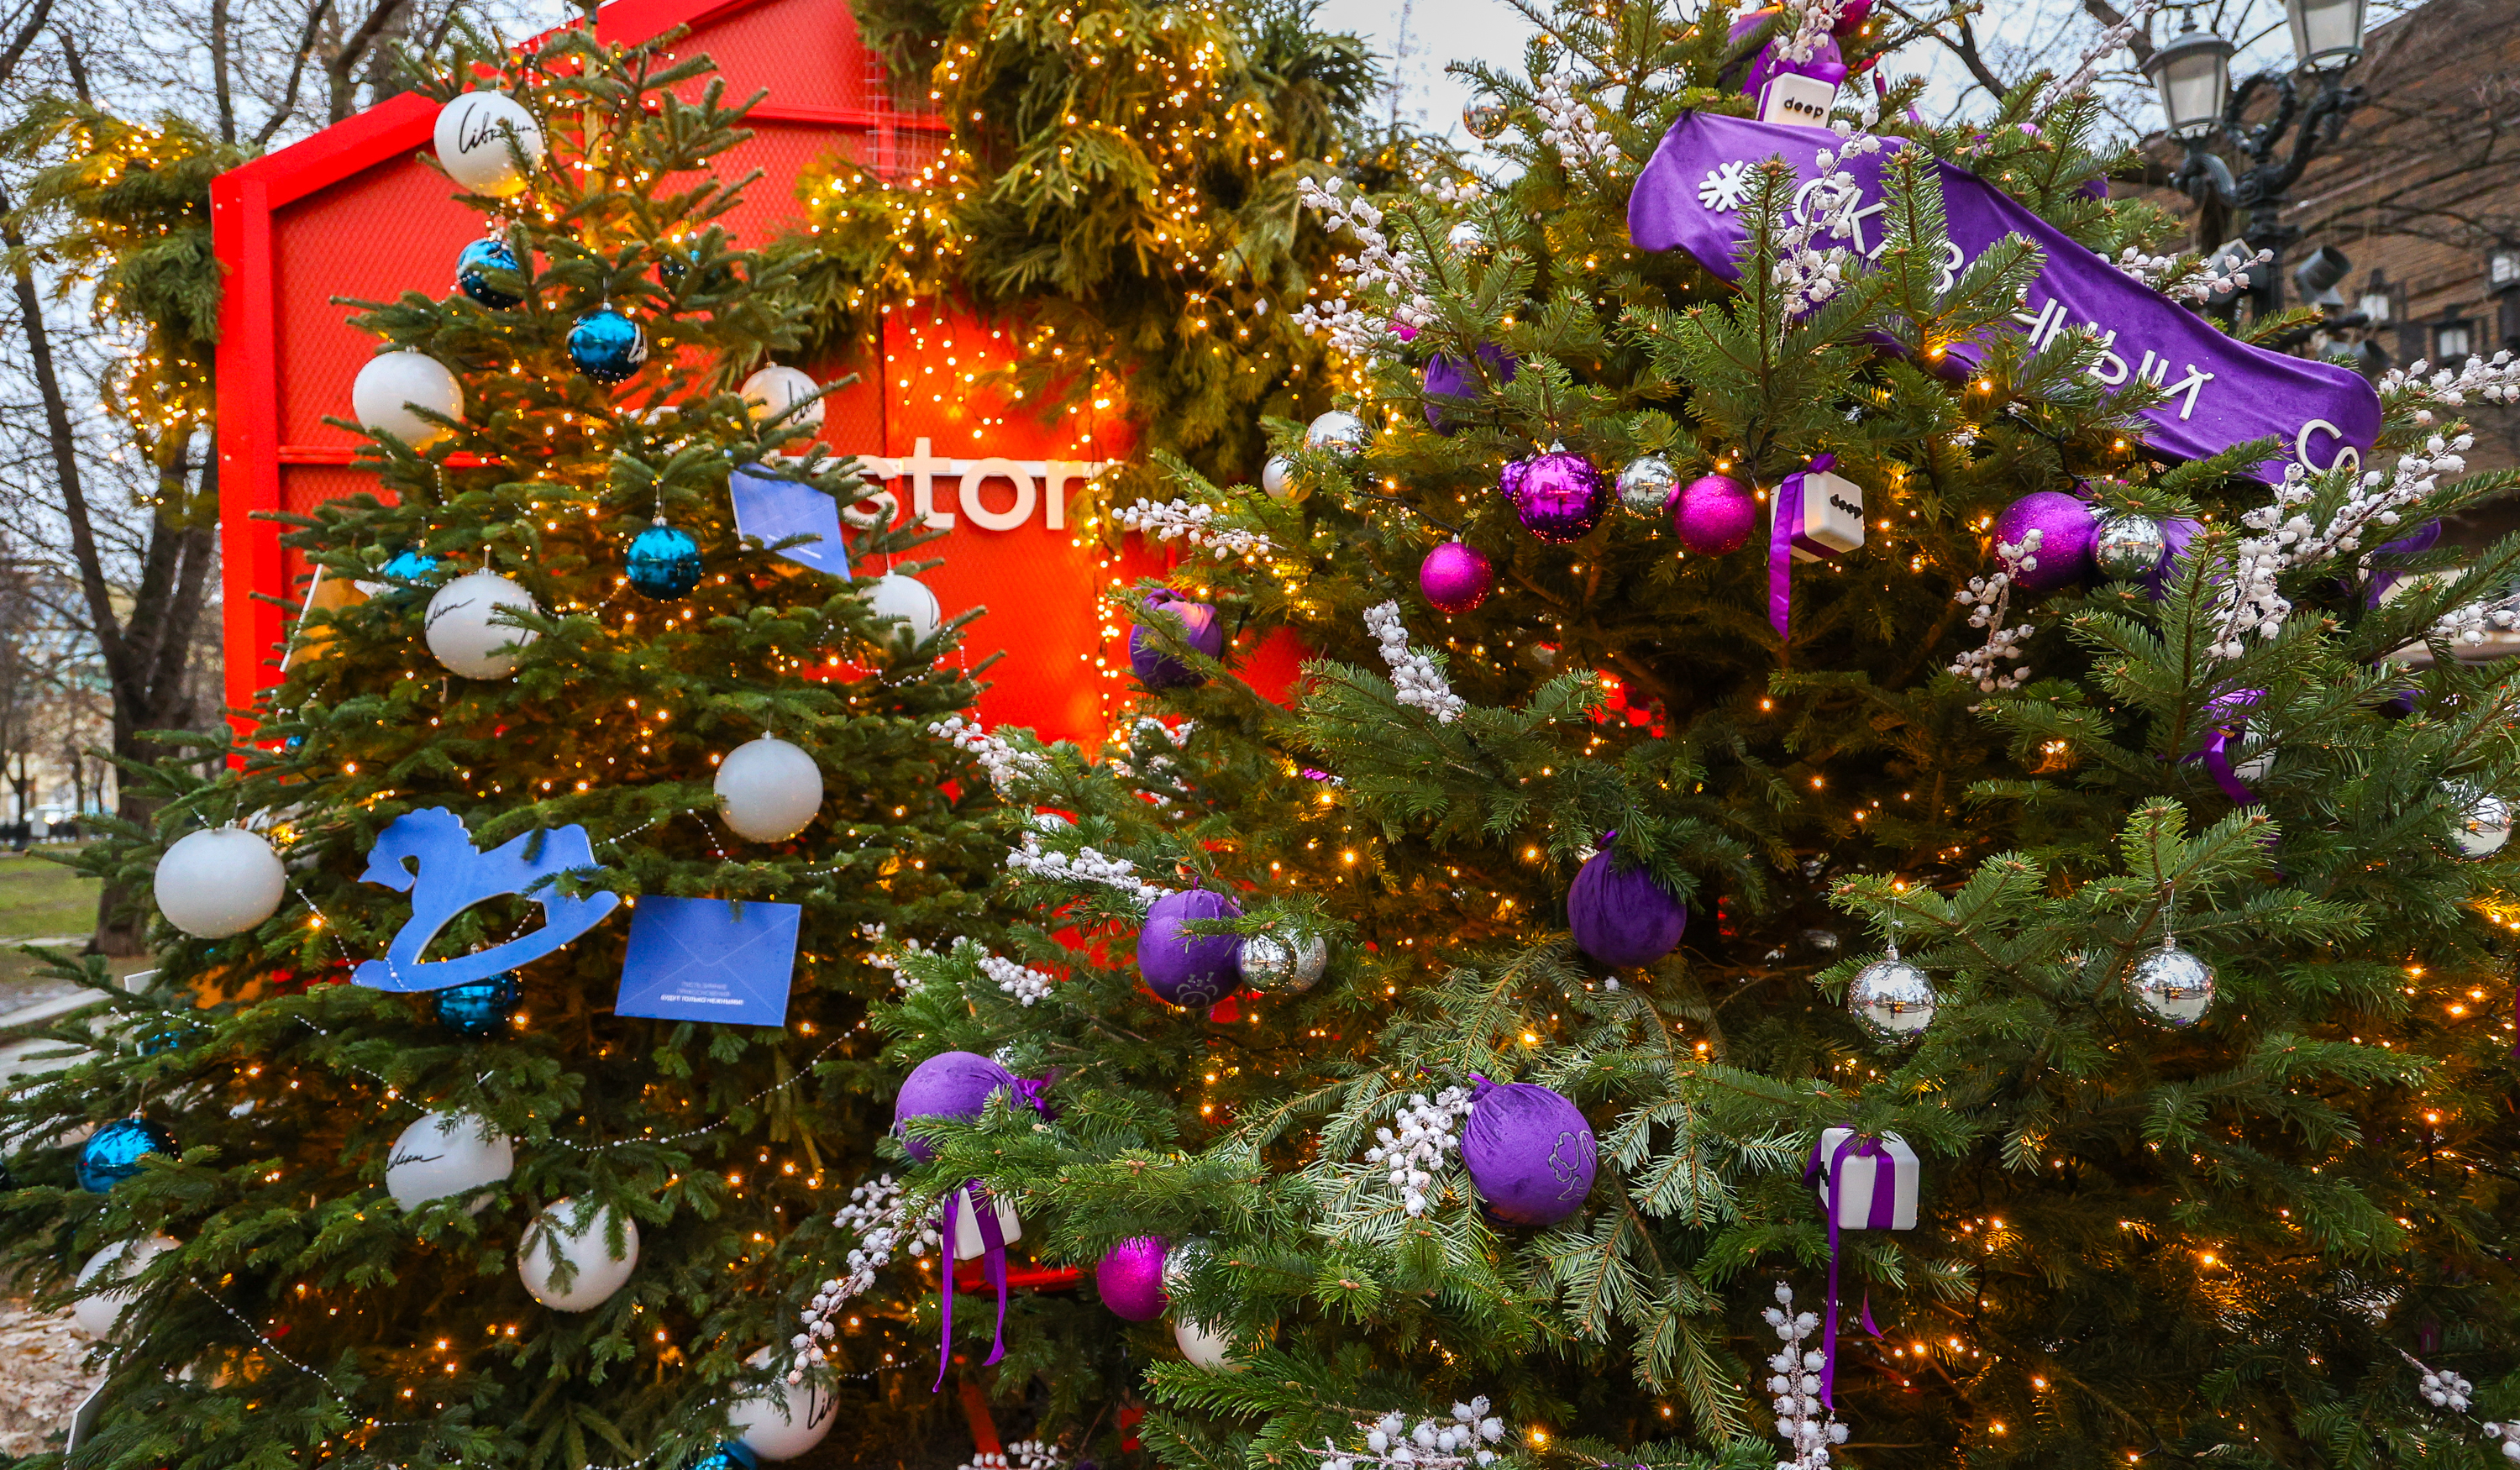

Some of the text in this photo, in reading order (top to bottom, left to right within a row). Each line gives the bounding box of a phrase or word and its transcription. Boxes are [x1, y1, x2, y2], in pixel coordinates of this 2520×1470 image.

[1784, 96, 1824, 119] deep
[842, 435, 1094, 531] stor
[1830, 493, 1863, 520] deep
